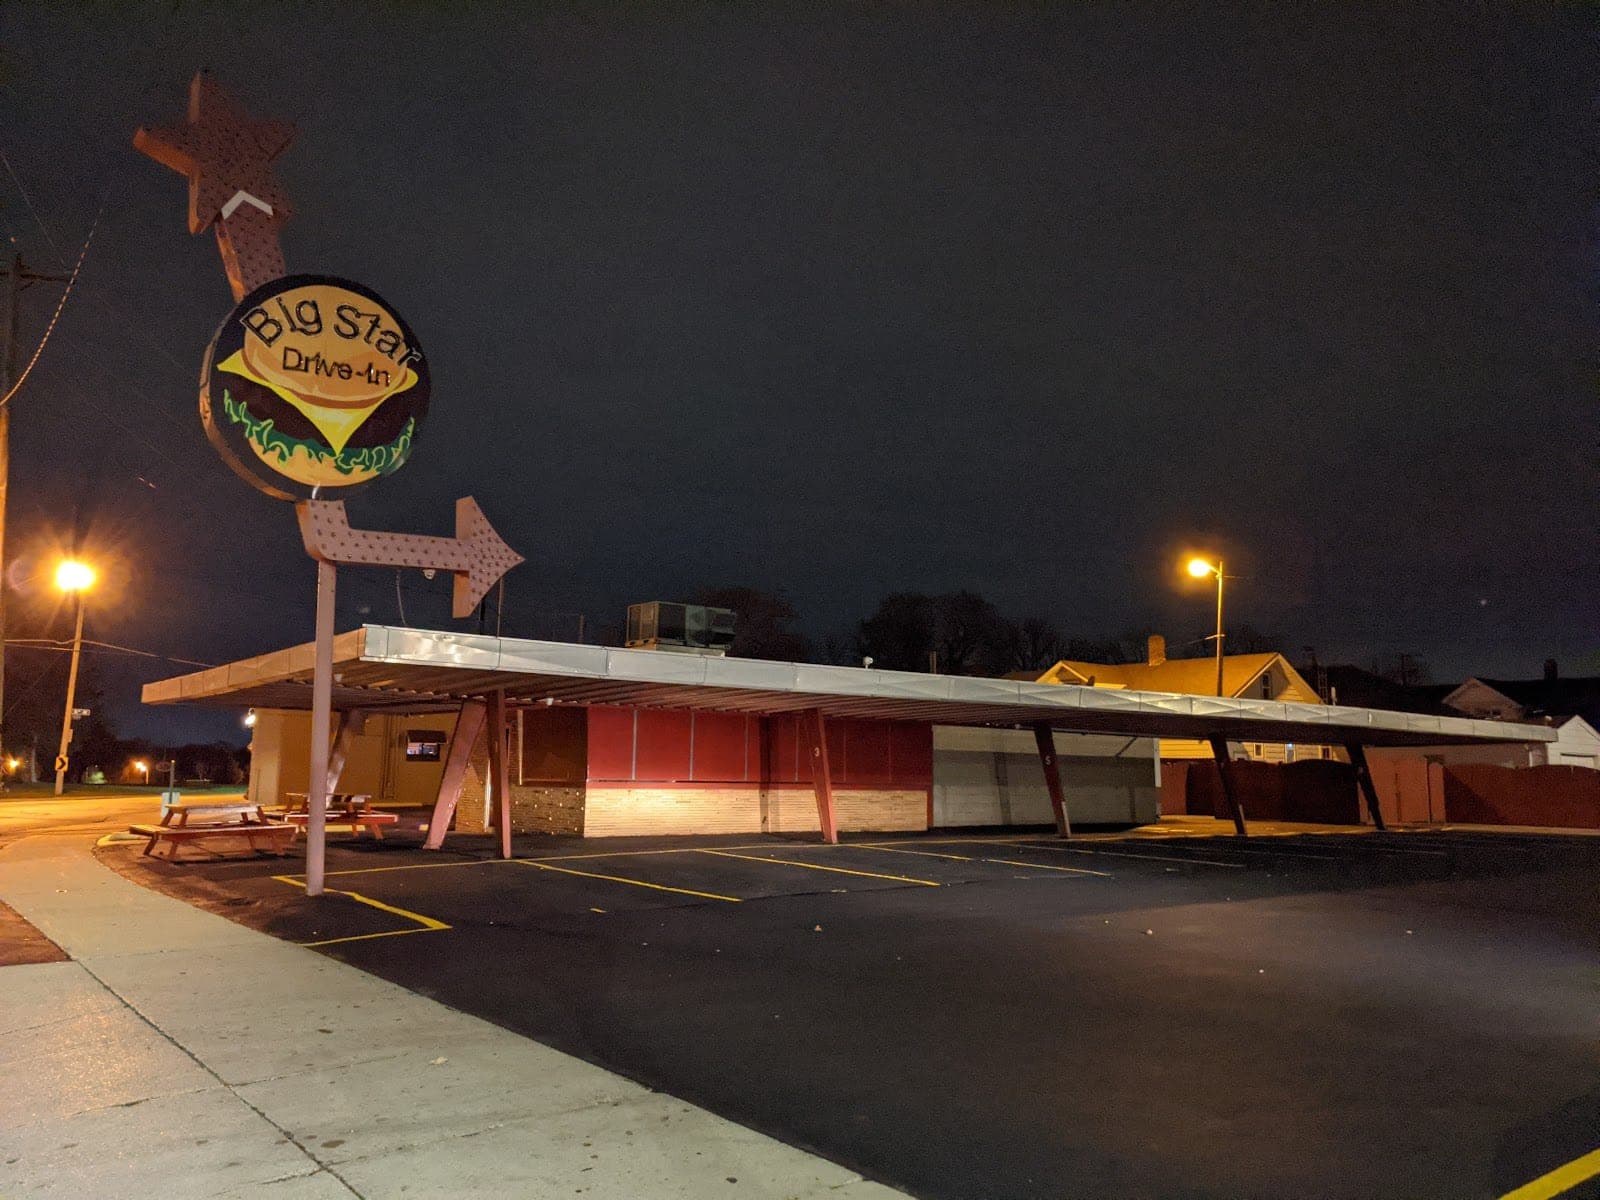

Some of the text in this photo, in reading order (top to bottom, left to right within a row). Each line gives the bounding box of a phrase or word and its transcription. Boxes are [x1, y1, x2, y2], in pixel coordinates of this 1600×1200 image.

[241, 296, 423, 366] Big Star
[282, 347, 390, 387] Drive-In
[814, 747, 820, 757] 3
